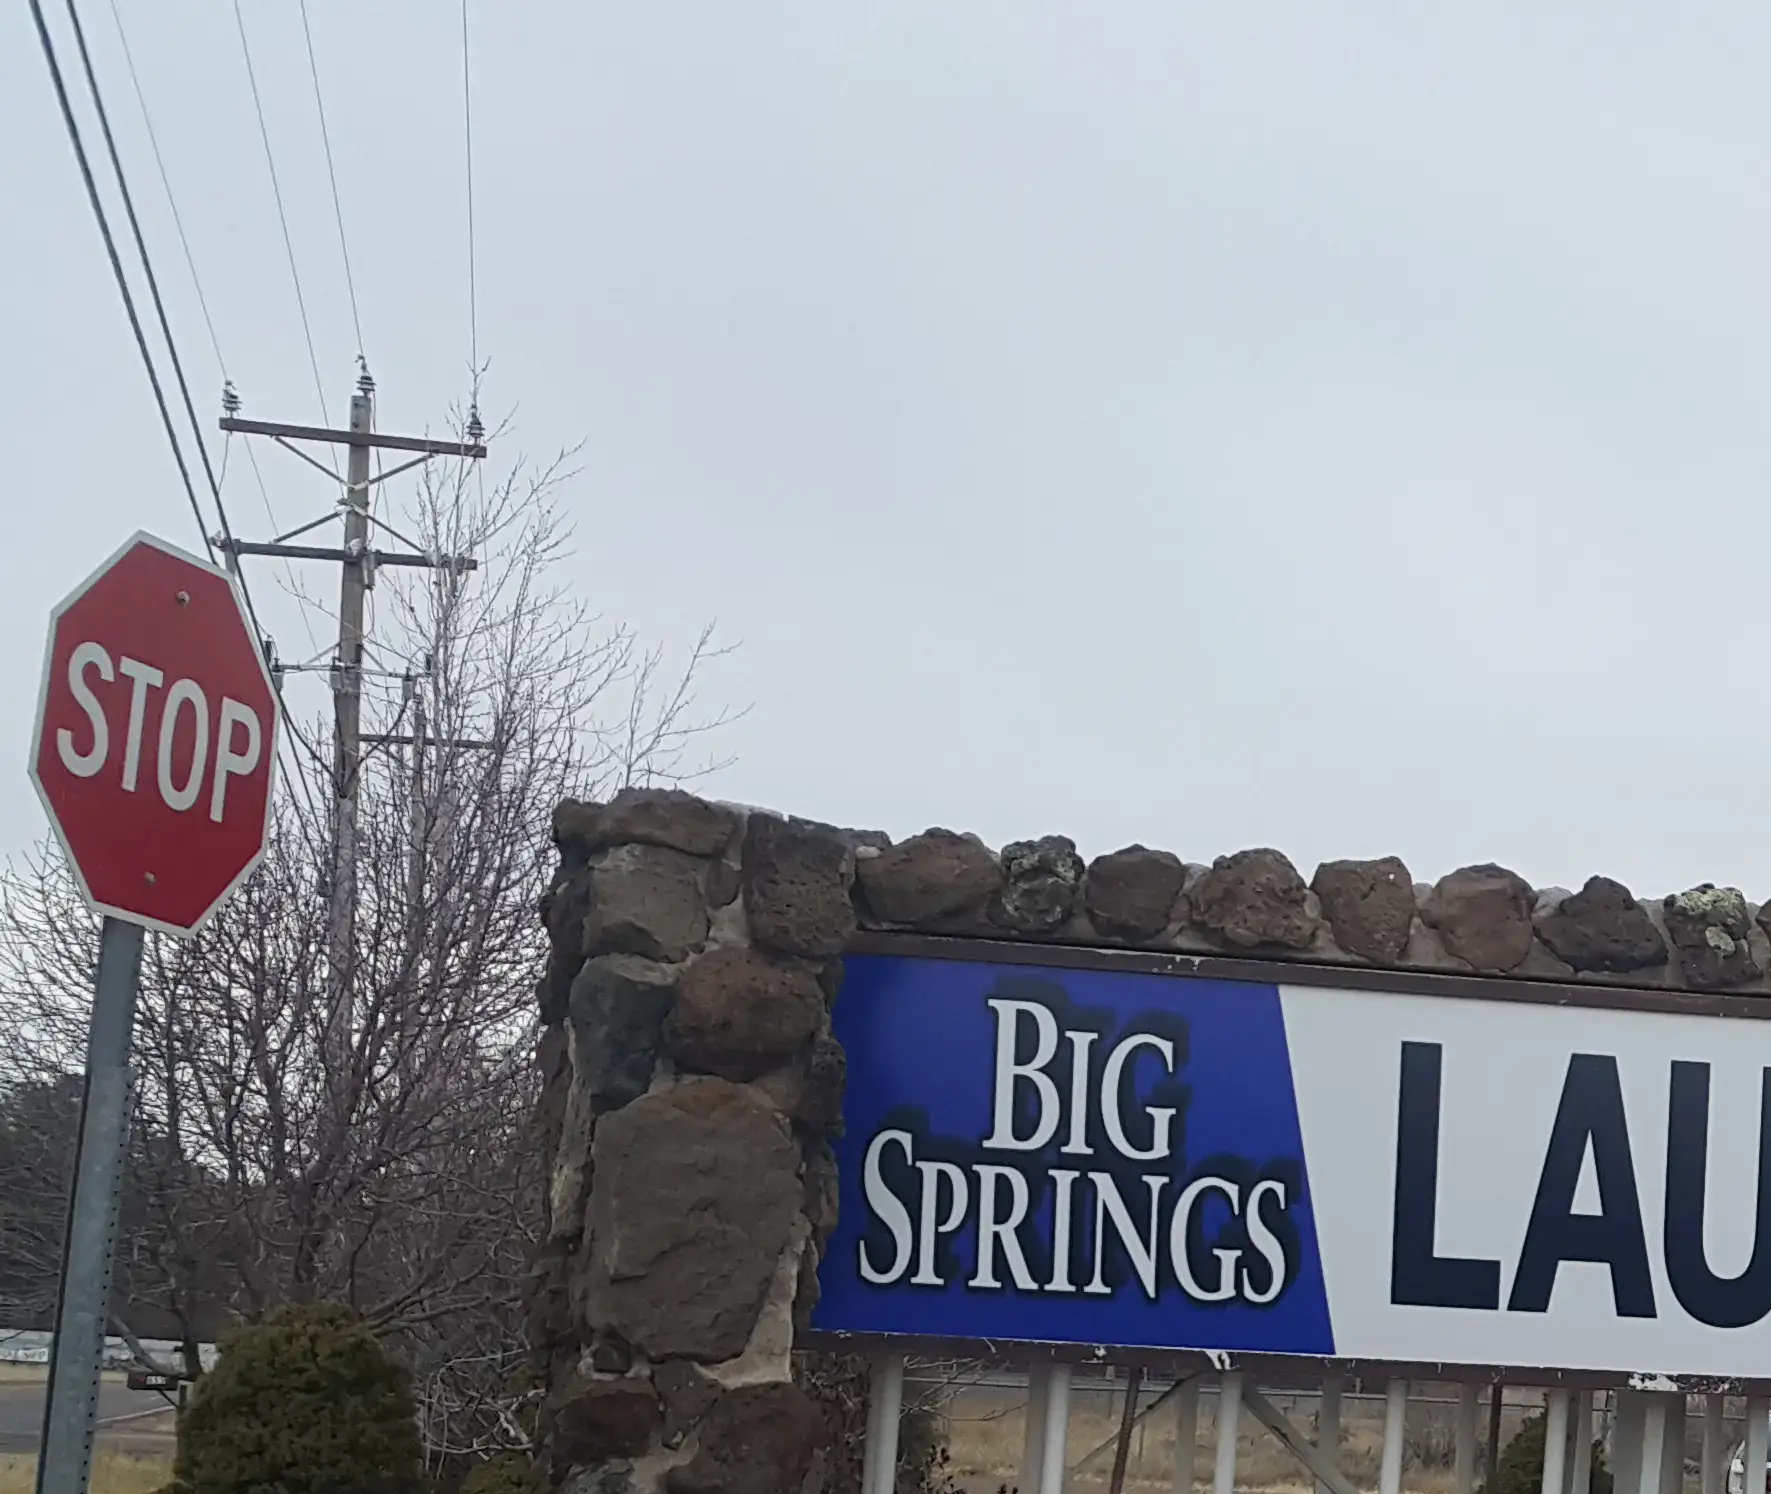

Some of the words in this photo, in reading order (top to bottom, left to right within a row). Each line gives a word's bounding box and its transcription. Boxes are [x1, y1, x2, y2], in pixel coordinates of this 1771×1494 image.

[57, 641, 262, 823] STOP
[982, 998, 1177, 1161] BIG
[859, 1129, 1288, 1304] SPRINGS
